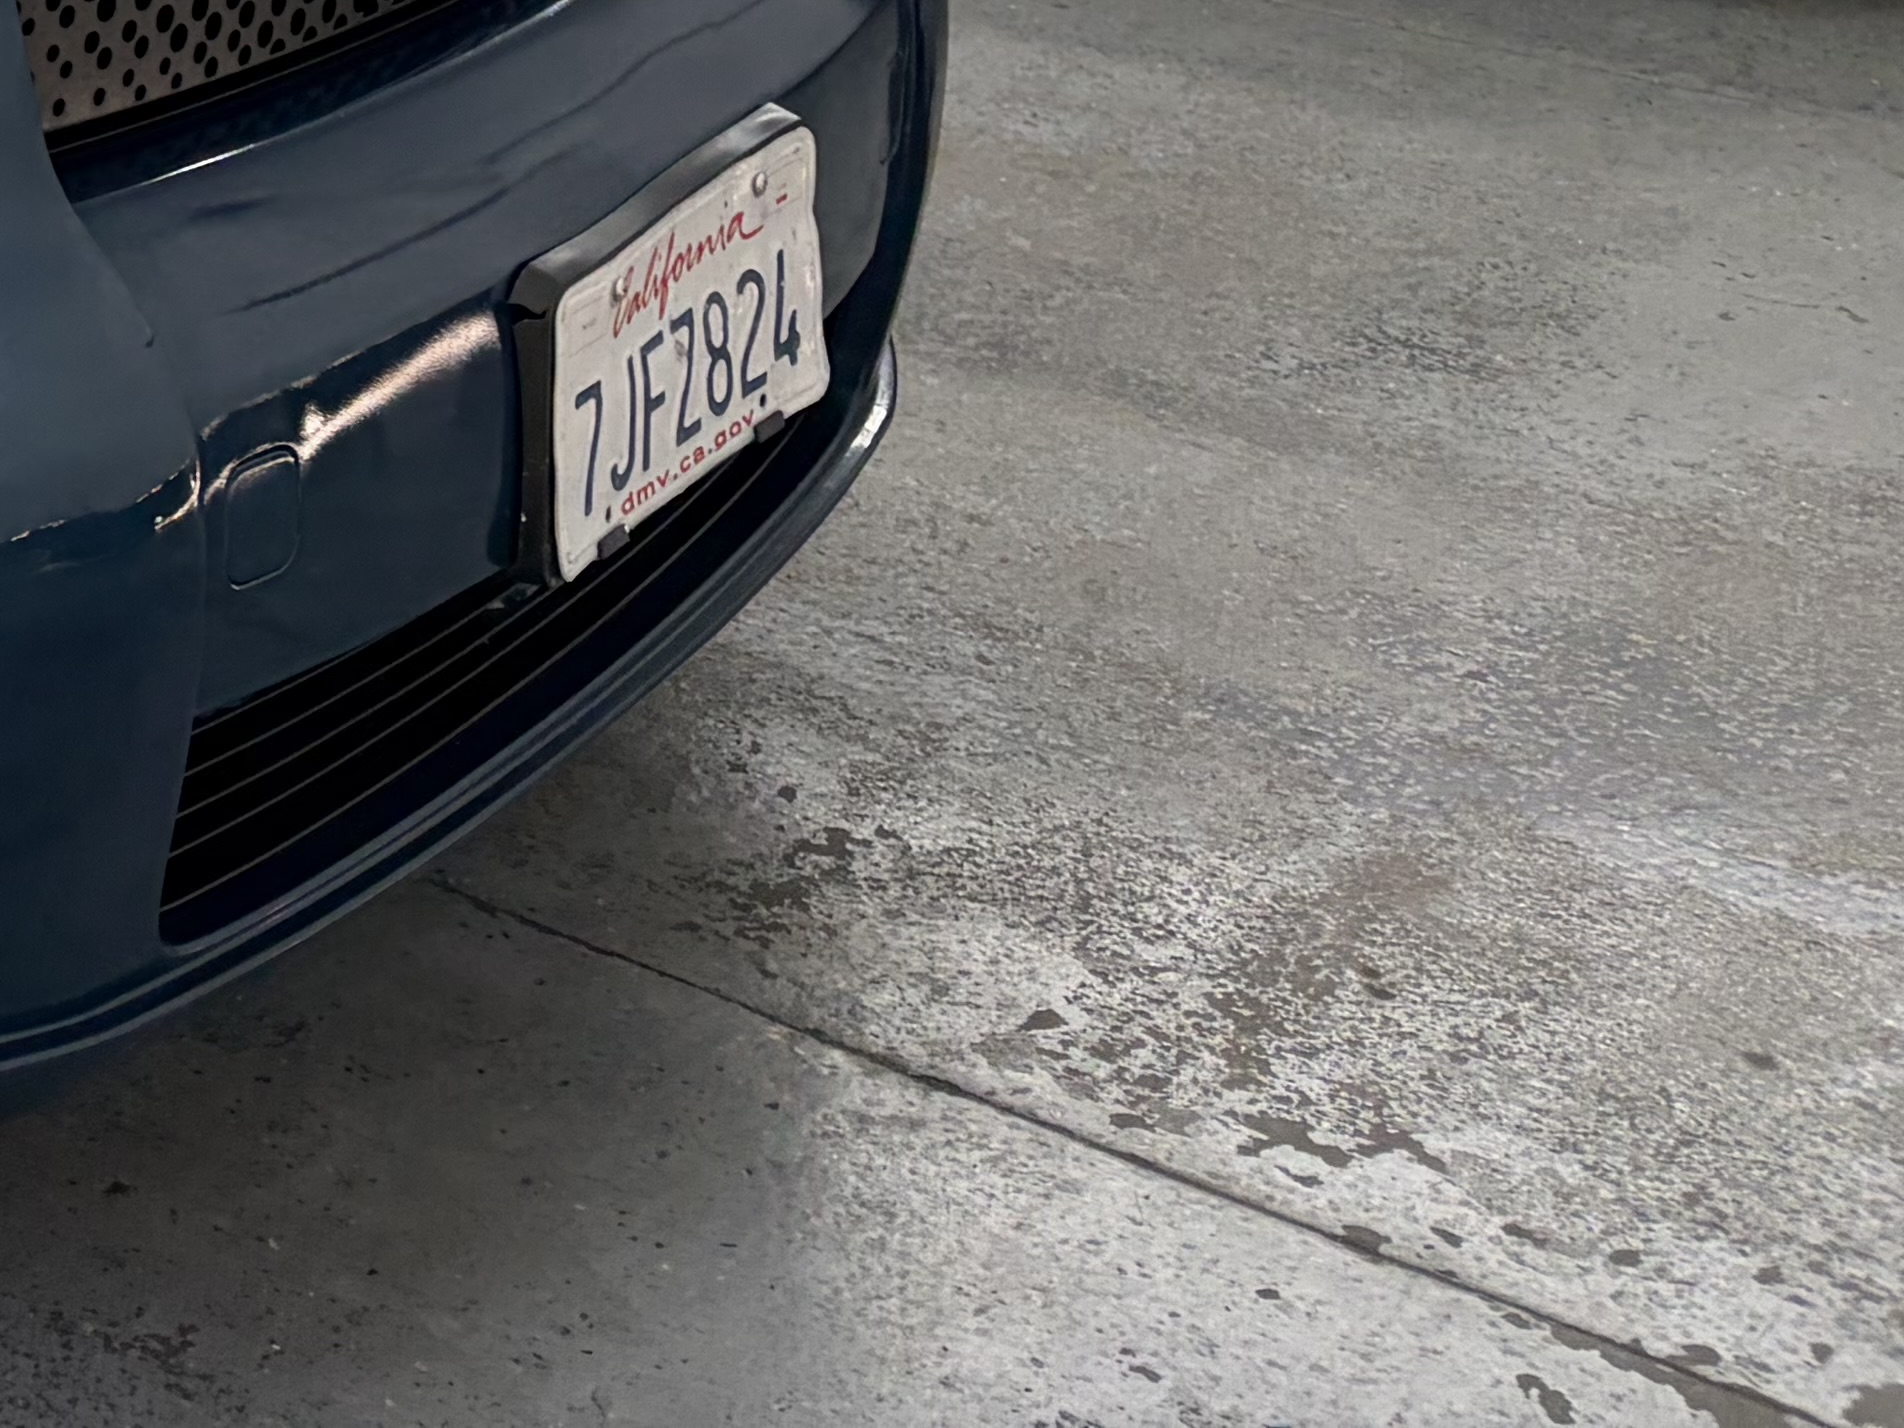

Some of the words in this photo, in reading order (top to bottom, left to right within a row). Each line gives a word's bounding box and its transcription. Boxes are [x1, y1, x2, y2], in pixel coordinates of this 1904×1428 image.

[613, 203, 764, 338] California
[575, 249, 802, 517] 7JFZ824
[621, 409, 755, 517] dmv.ca.gov
